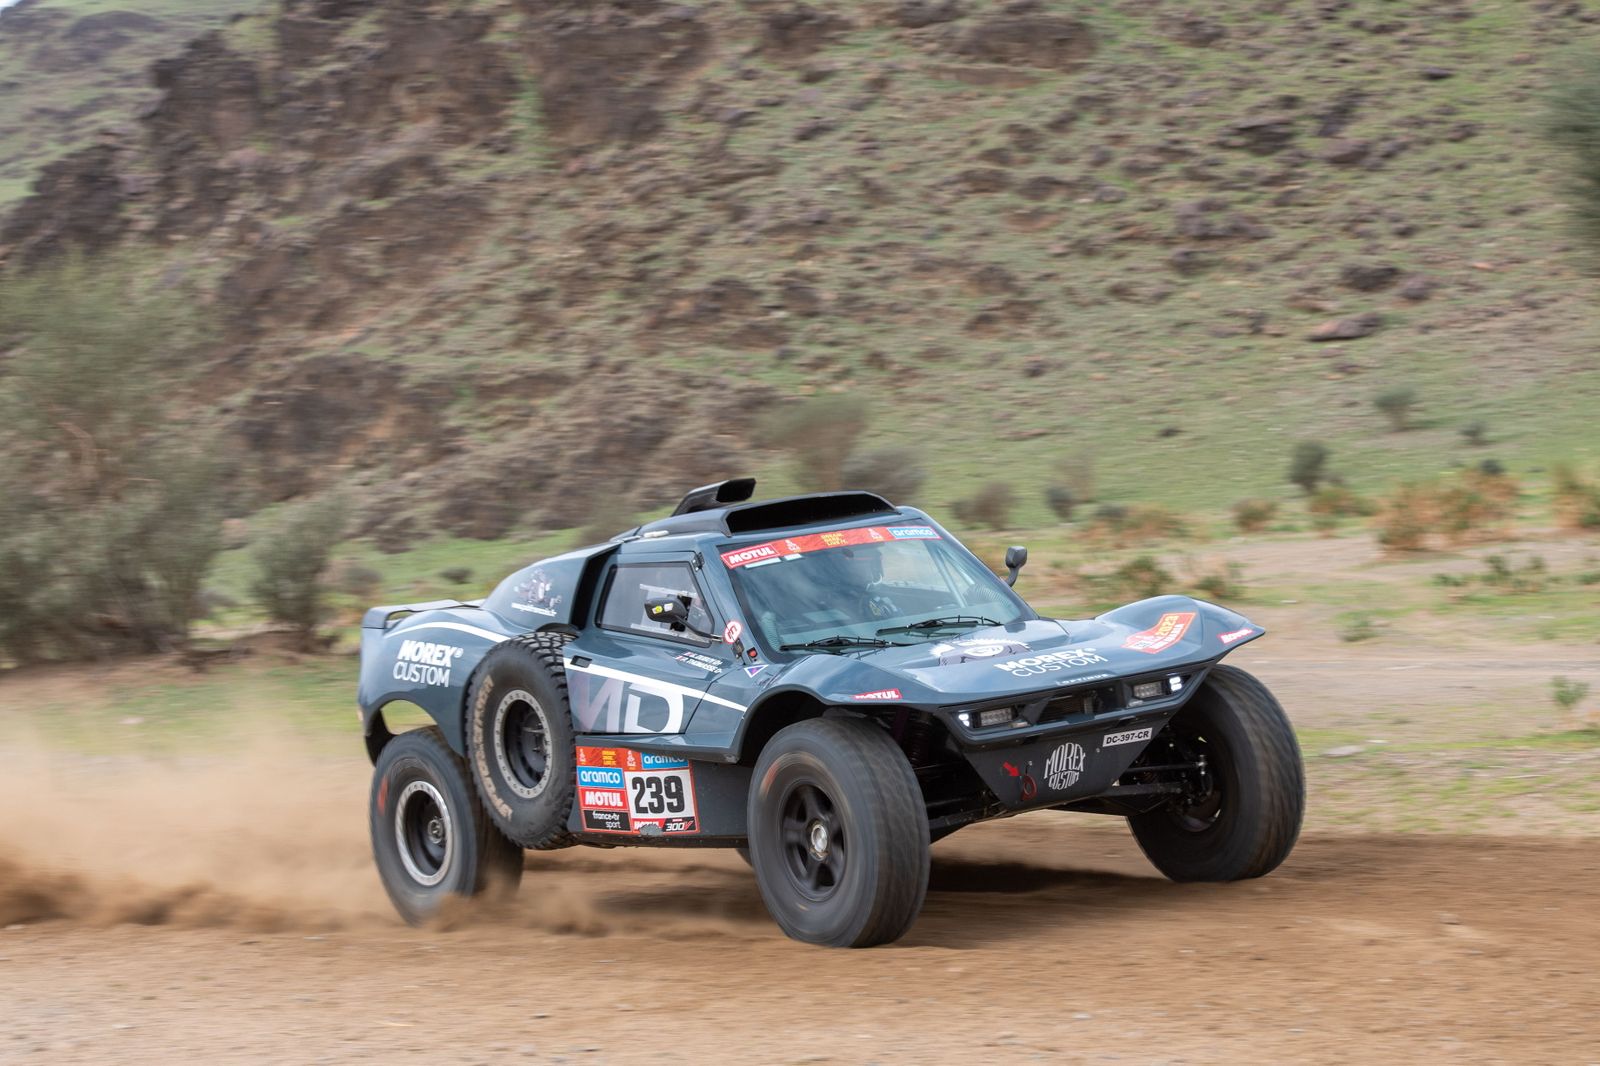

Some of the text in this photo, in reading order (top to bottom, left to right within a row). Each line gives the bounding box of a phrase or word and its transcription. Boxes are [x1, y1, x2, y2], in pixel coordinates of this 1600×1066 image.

[728, 547, 775, 564] MOTUL
[393, 661, 450, 688] CUSTOM
[1011, 655, 1109, 677] CUSTOM
[1106, 731, 1149, 744] DC-397-CR
[1043, 742, 1086, 779] MOREX
[580, 771, 621, 784] aramco
[1048, 771, 1080, 790] CUSTOM
[585, 791, 623, 807] MOTUL
[631, 776, 685, 814] 239
[606, 821, 621, 830] sport
